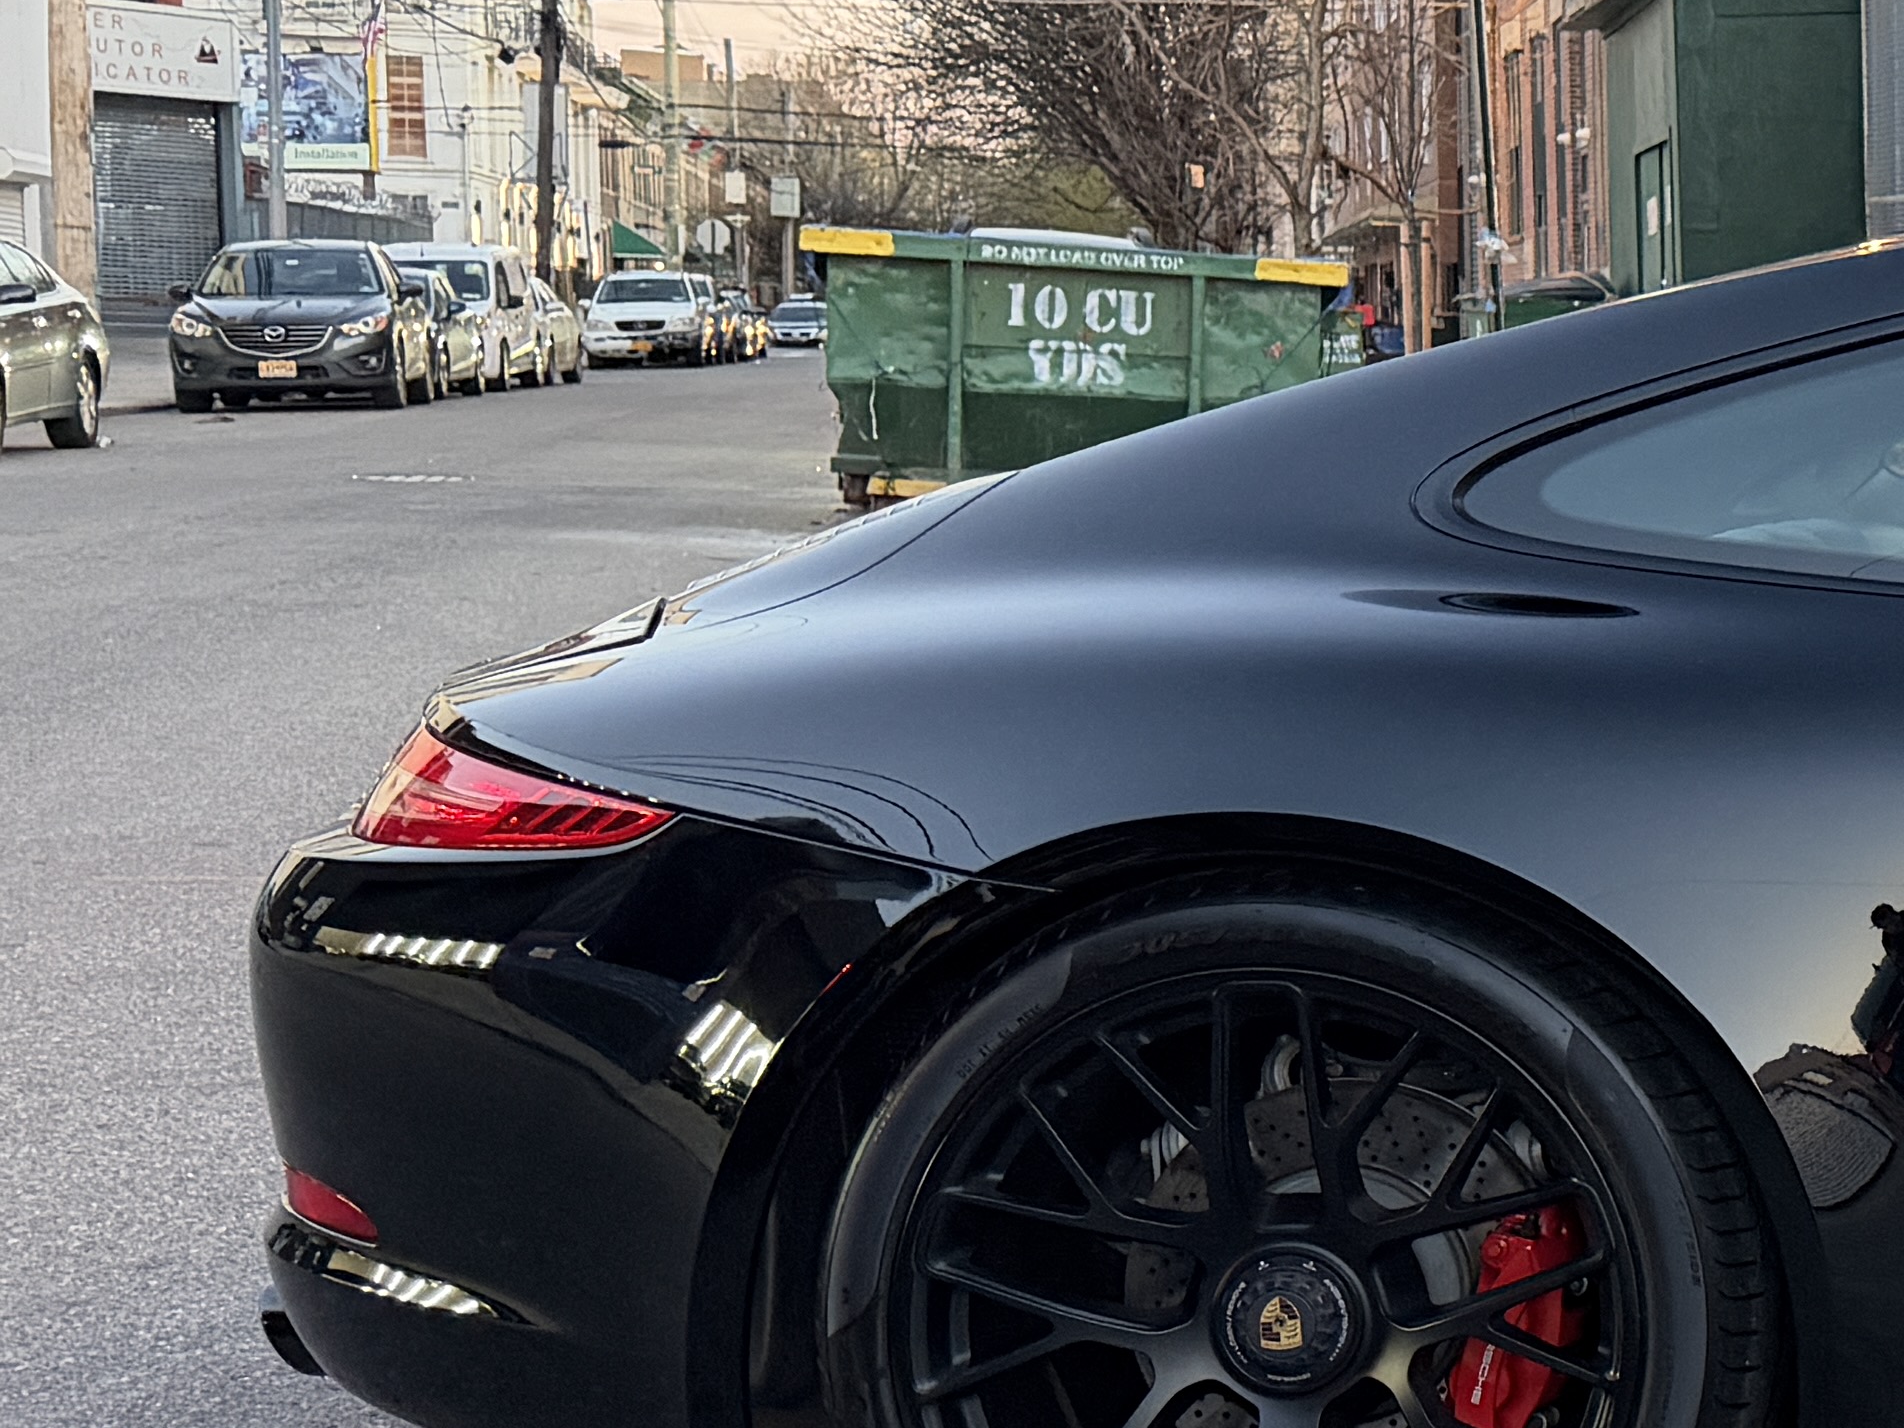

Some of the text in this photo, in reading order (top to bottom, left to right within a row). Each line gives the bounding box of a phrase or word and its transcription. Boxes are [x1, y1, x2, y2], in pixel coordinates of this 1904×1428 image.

[1011, 246, 1048, 264] NOT
[1100, 252, 1146, 270] OVER
[1150, 254, 1184, 271] TOP
[1007, 283, 1156, 336] 10 CU
[1028, 339, 1127, 388] YDS
